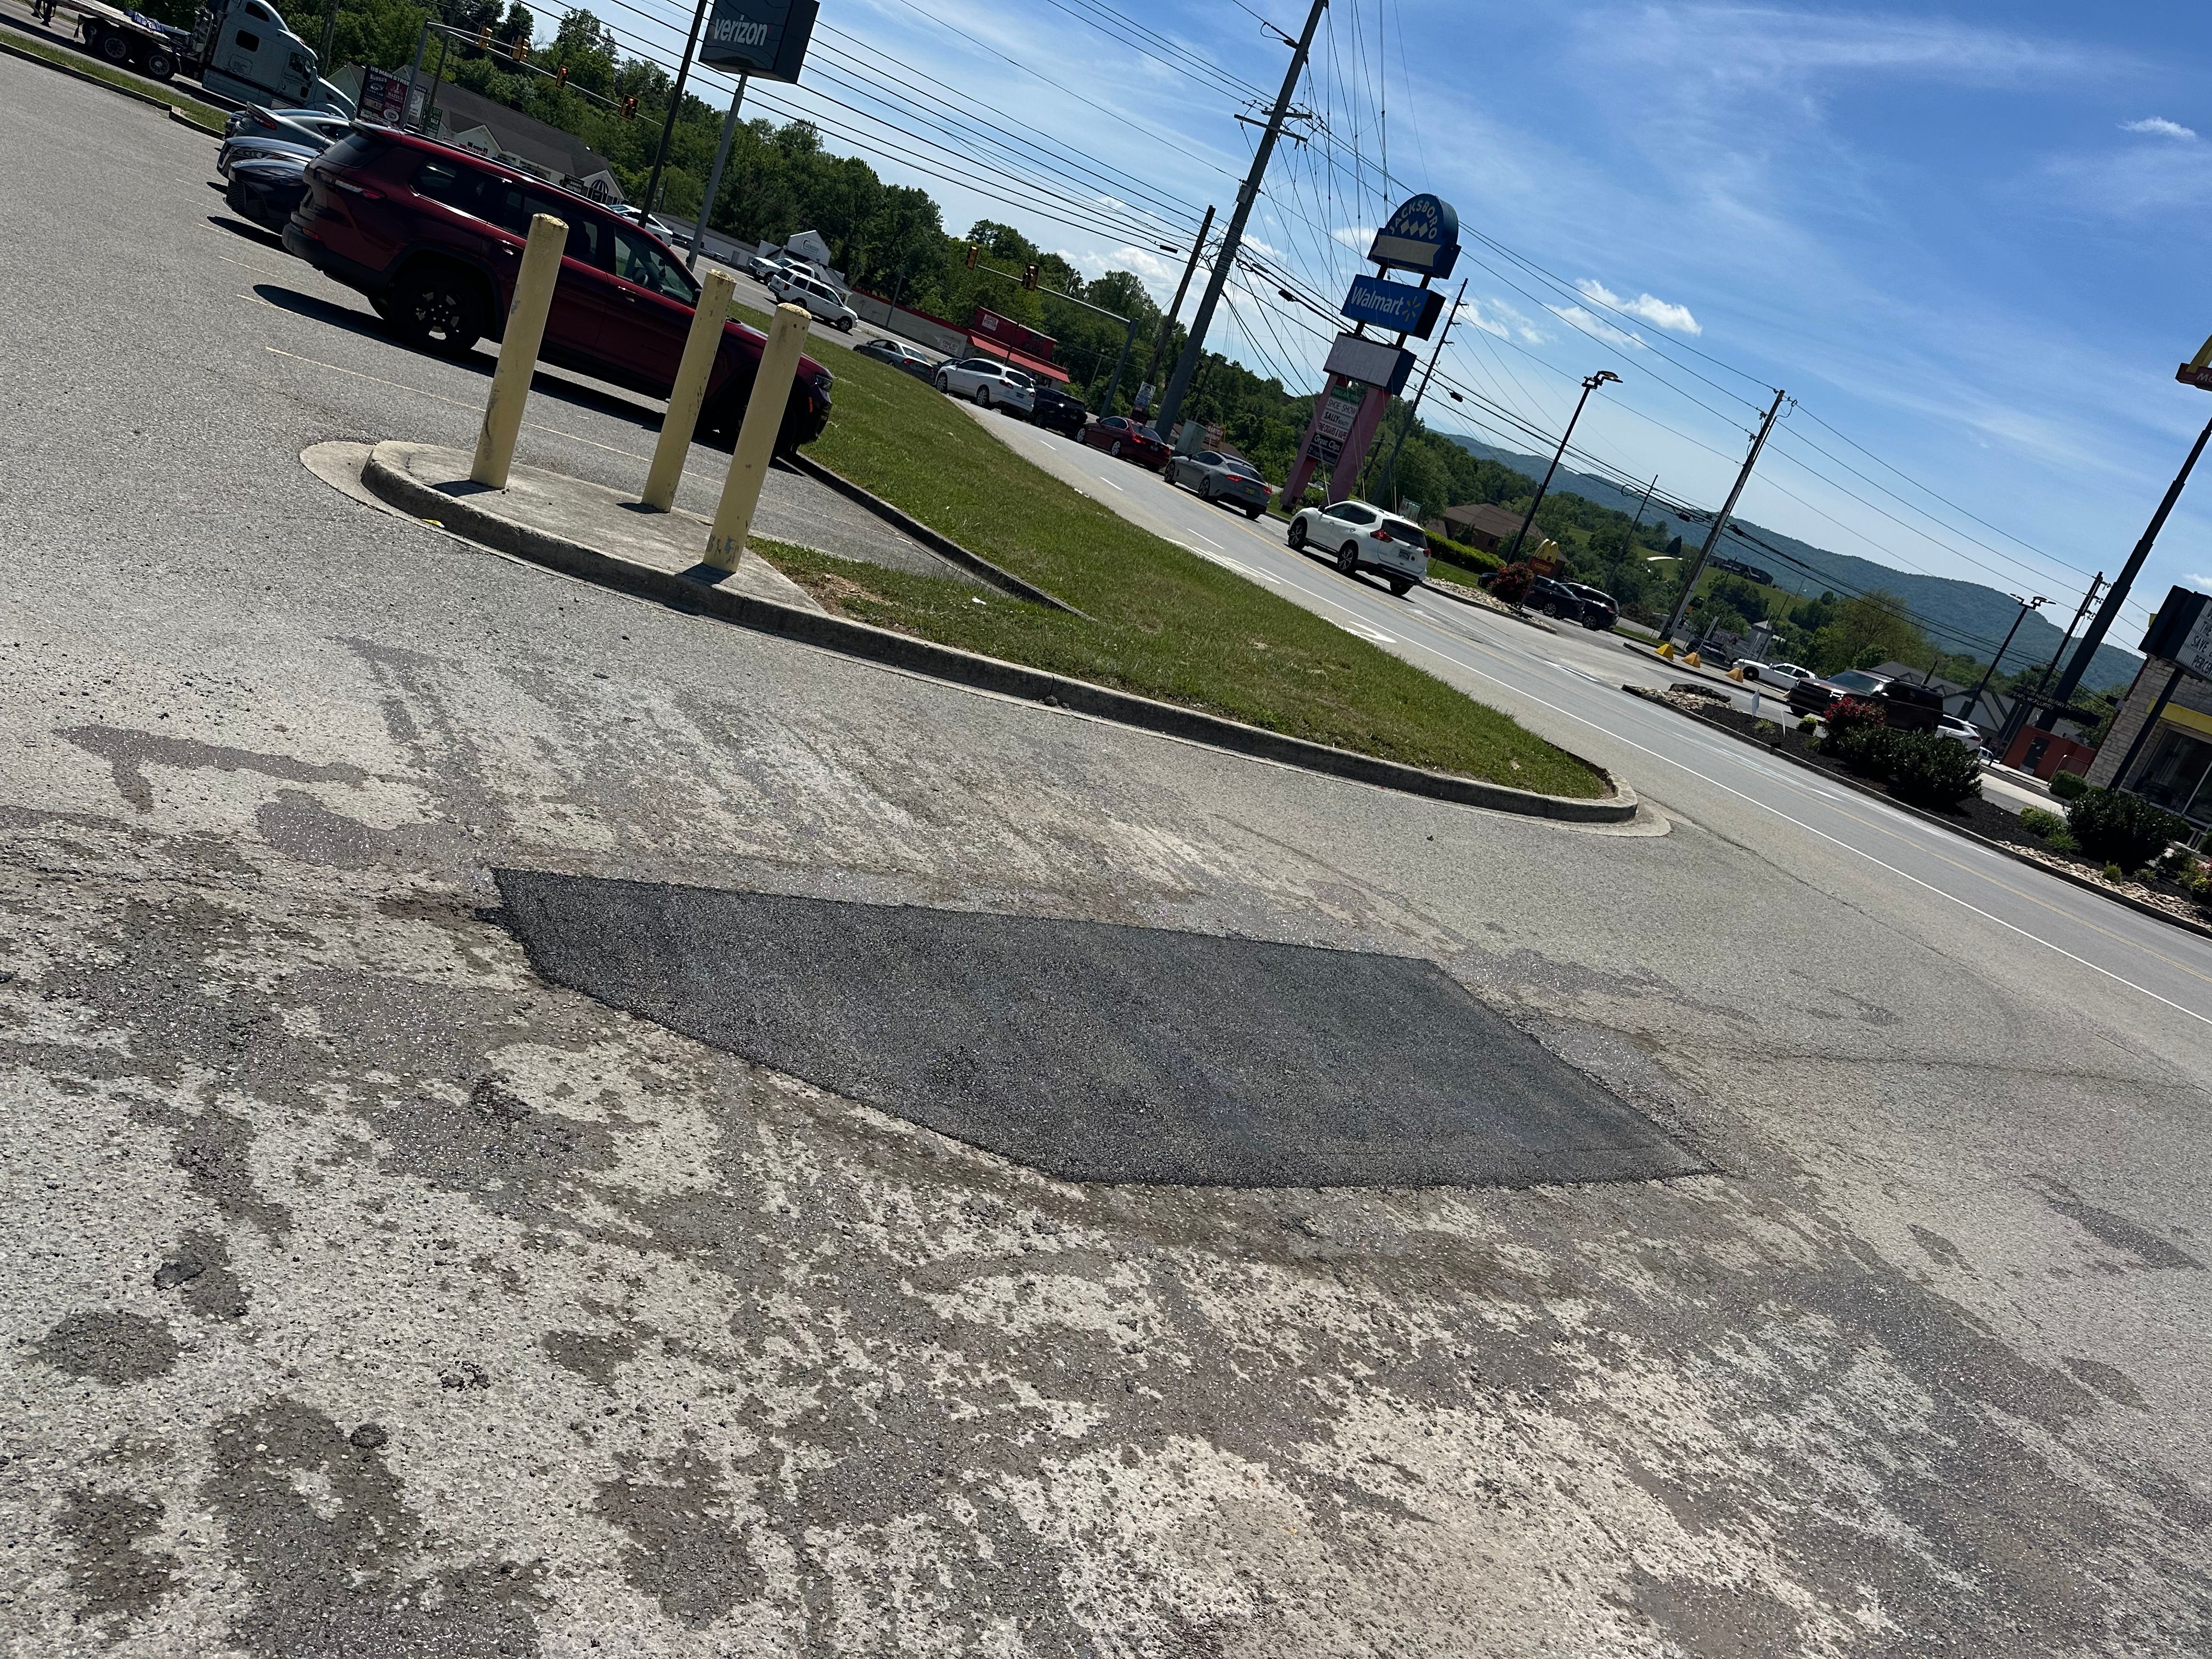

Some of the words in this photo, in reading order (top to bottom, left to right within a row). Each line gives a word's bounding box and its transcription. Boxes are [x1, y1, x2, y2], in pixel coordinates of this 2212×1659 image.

[714, 15, 768, 46] verizon
[379, 70, 394, 80] MAIN
[393, 76, 410, 86] STREE
[430, 117, 439, 125] SALE
[1389, 200, 1437, 239] JACKSBORO
[1351, 286, 1404, 315] Walmart
[1327, 399, 1341, 410] SHOE
[1341, 404, 1357, 415] SHOW
[1324, 411, 1340, 422] SALLY
[1324, 425, 1336, 435] CIGARS
[1338, 431, 1347, 439] VAPE
[1314, 434, 1328, 445] Great
[1328, 441, 1340, 452] Clips
[2191, 636, 2209, 653] SAVE
[2010, 691, 2026, 701] PEARL
[2049, 698, 2064, 708] BERRY
